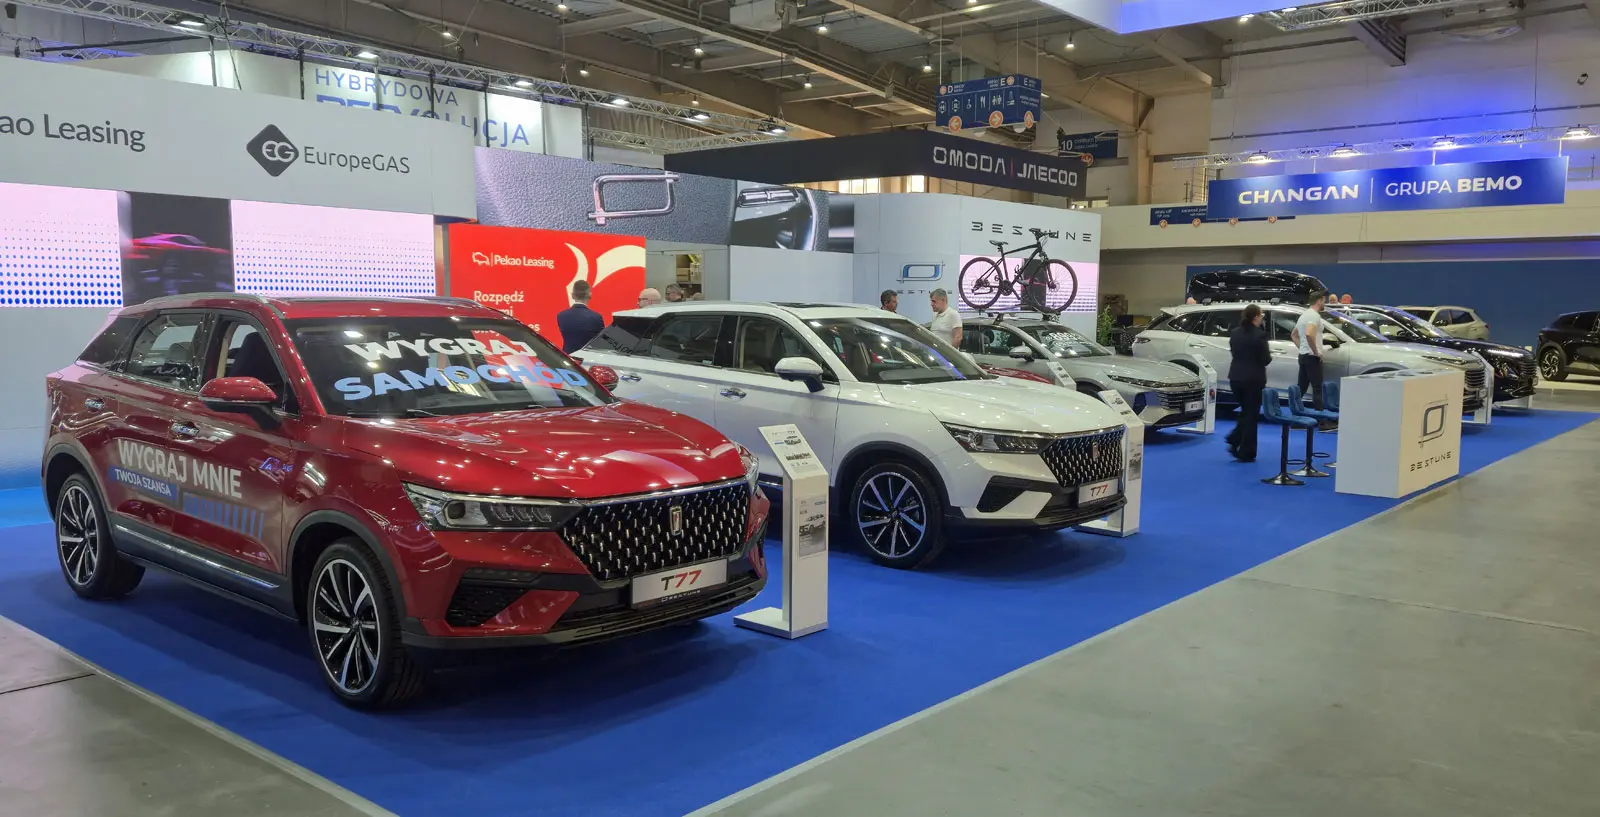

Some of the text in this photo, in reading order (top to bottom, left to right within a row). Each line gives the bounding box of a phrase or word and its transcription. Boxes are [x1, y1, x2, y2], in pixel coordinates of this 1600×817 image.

[315, 68, 459, 107] HYBRYDOWA
[1000, 77, 1006, 86] E
[44, 113, 146, 152] Leasing
[1061, 140, 1073, 150] 10
[304, 146, 411, 174] EuropeGAS
[933, 146, 1077, 187] OMODA JAECOO
[1238, 175, 1523, 205] CHANGAN GRUPA BEMO
[494, 254, 555, 269] Pekao Leasing
[473, 290, 525, 305] Rozpędź
[344, 338, 537, 362] WYGRAJ
[334, 361, 588, 401] SAMOCHÓD
[118, 439, 242, 498] WYGRAJ MNIE
[1410, 451, 1451, 472] BESTUNE
[115, 468, 172, 497] TWOJA SZANSA
[1090, 484, 1108, 497] T77
[661, 569, 702, 591] T77
